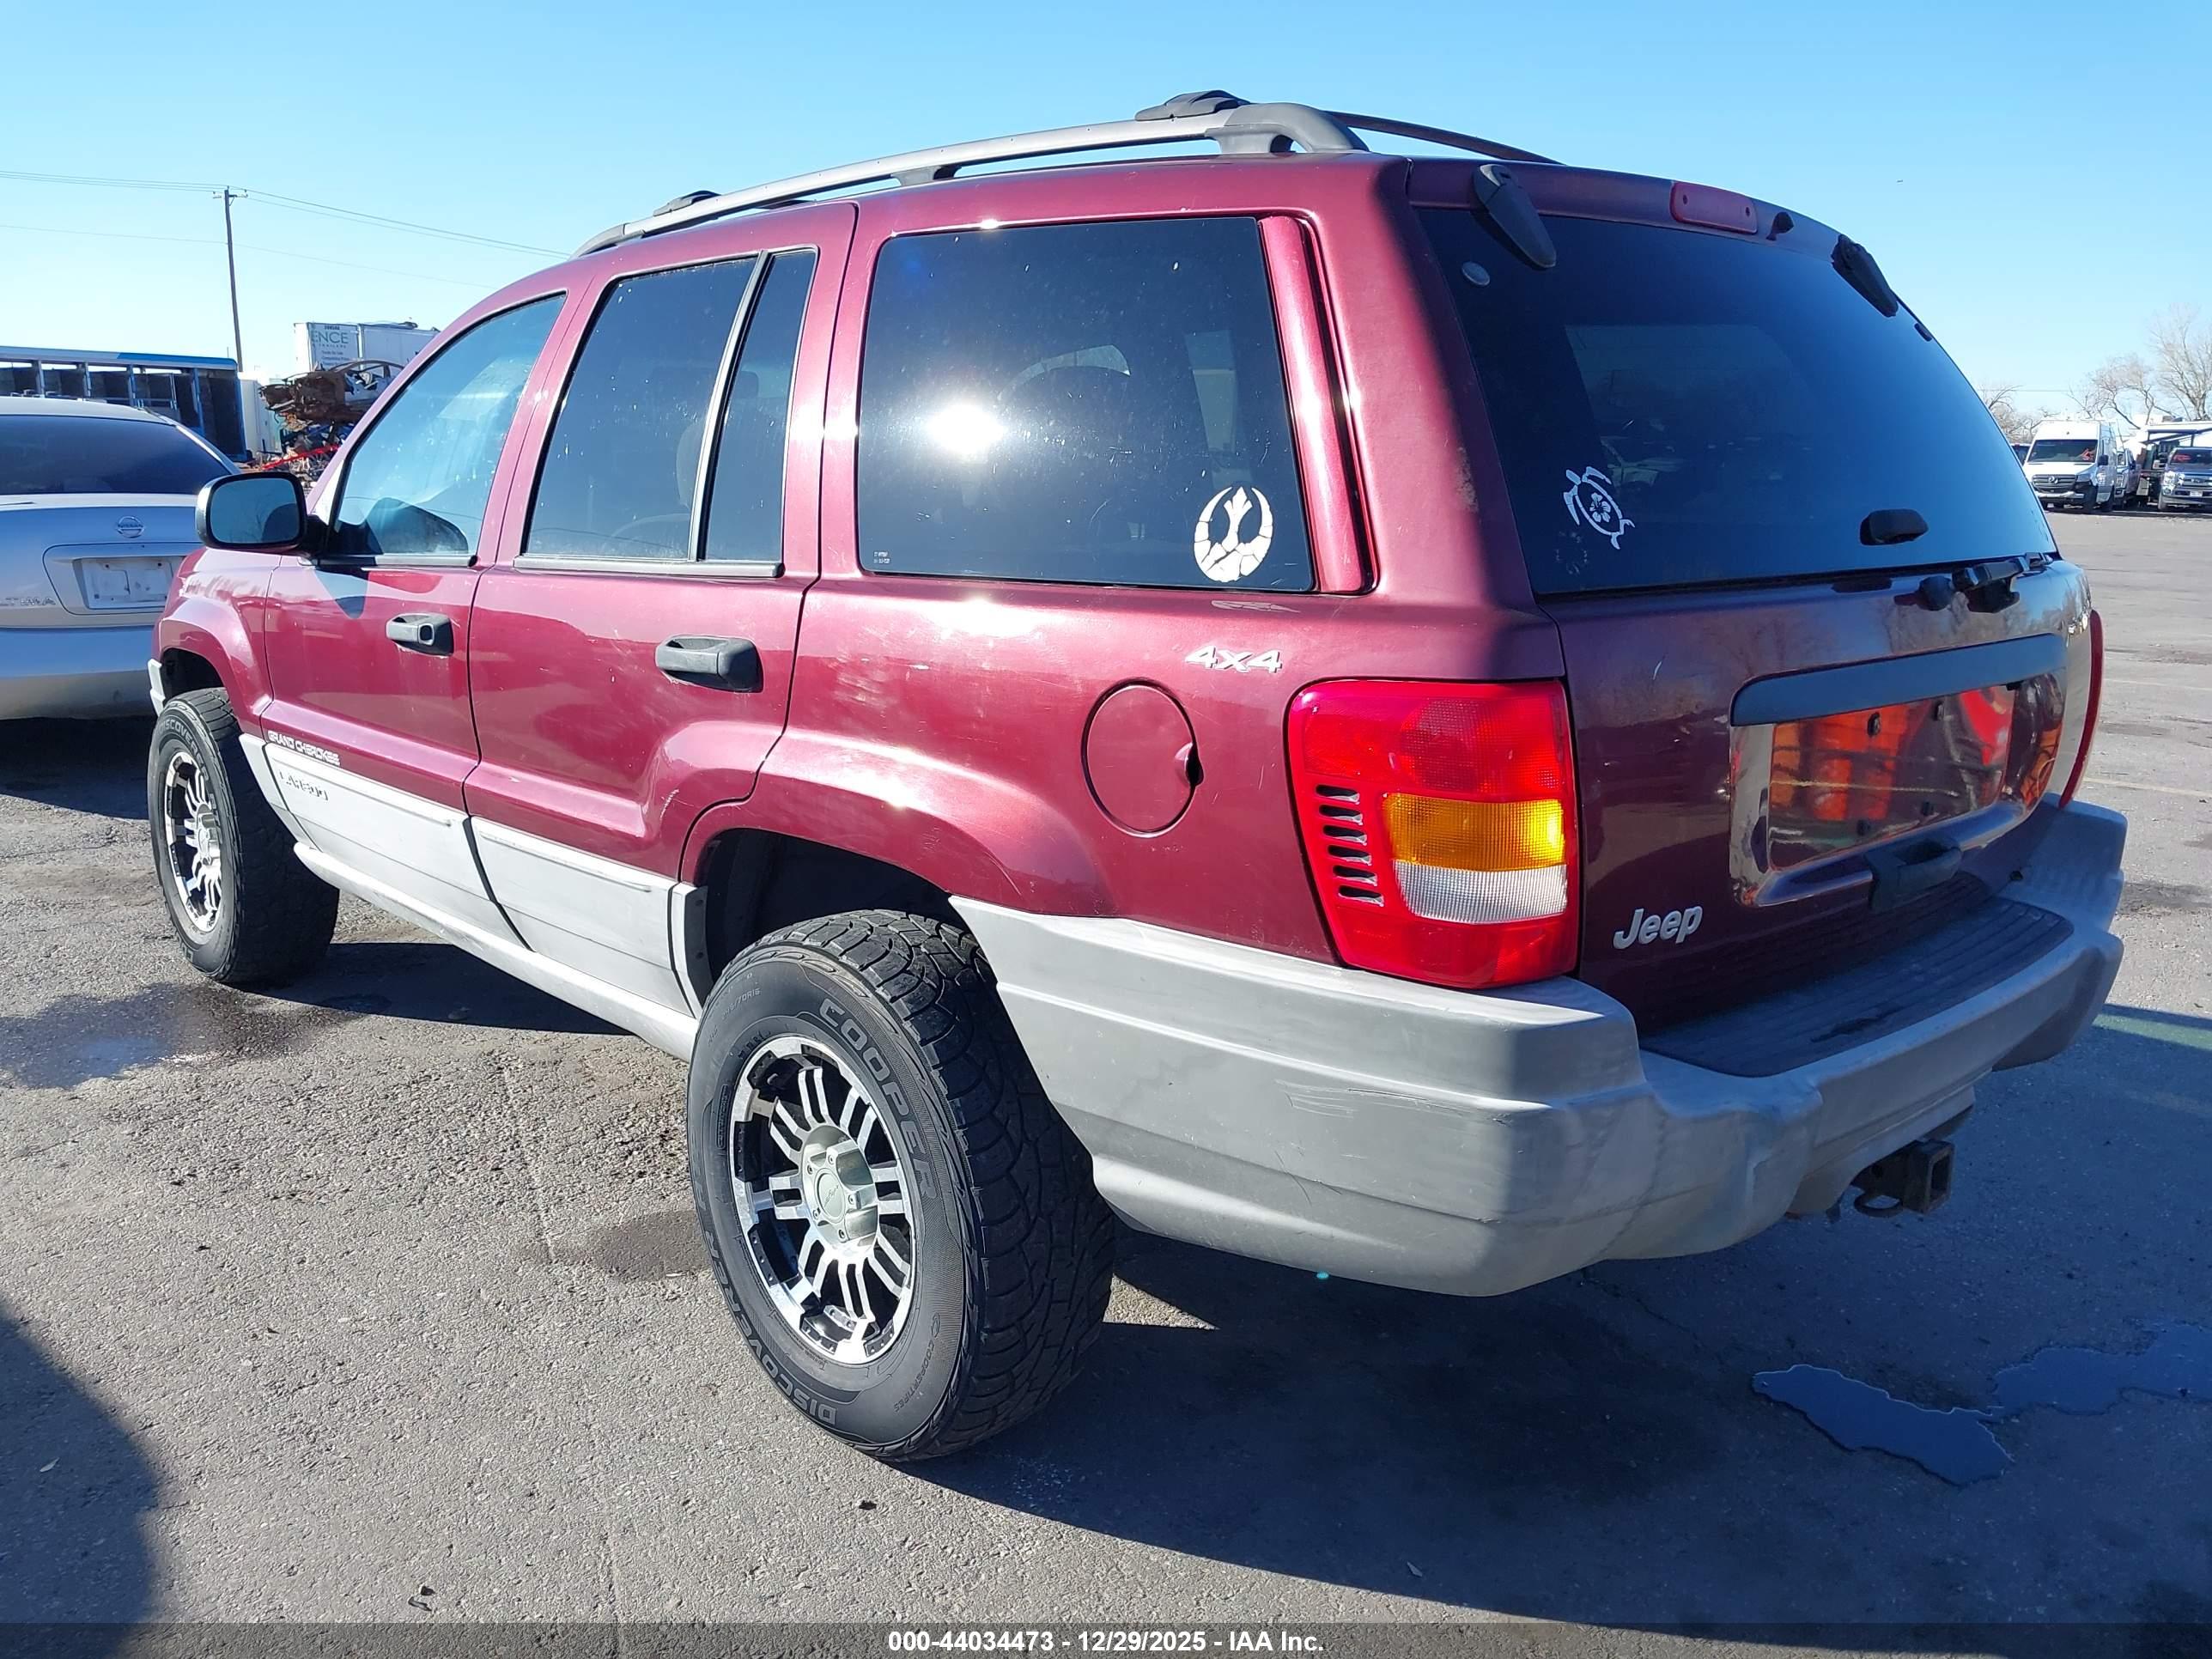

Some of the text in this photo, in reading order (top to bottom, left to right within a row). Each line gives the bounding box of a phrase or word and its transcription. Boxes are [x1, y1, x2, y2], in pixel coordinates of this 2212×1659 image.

[267, 730, 295, 750] GRAND
[1613, 905, 1704, 950] Jeep
[818, 997, 938, 1200] COOPER
[704, 1230, 837, 1425] DISCOVERER
